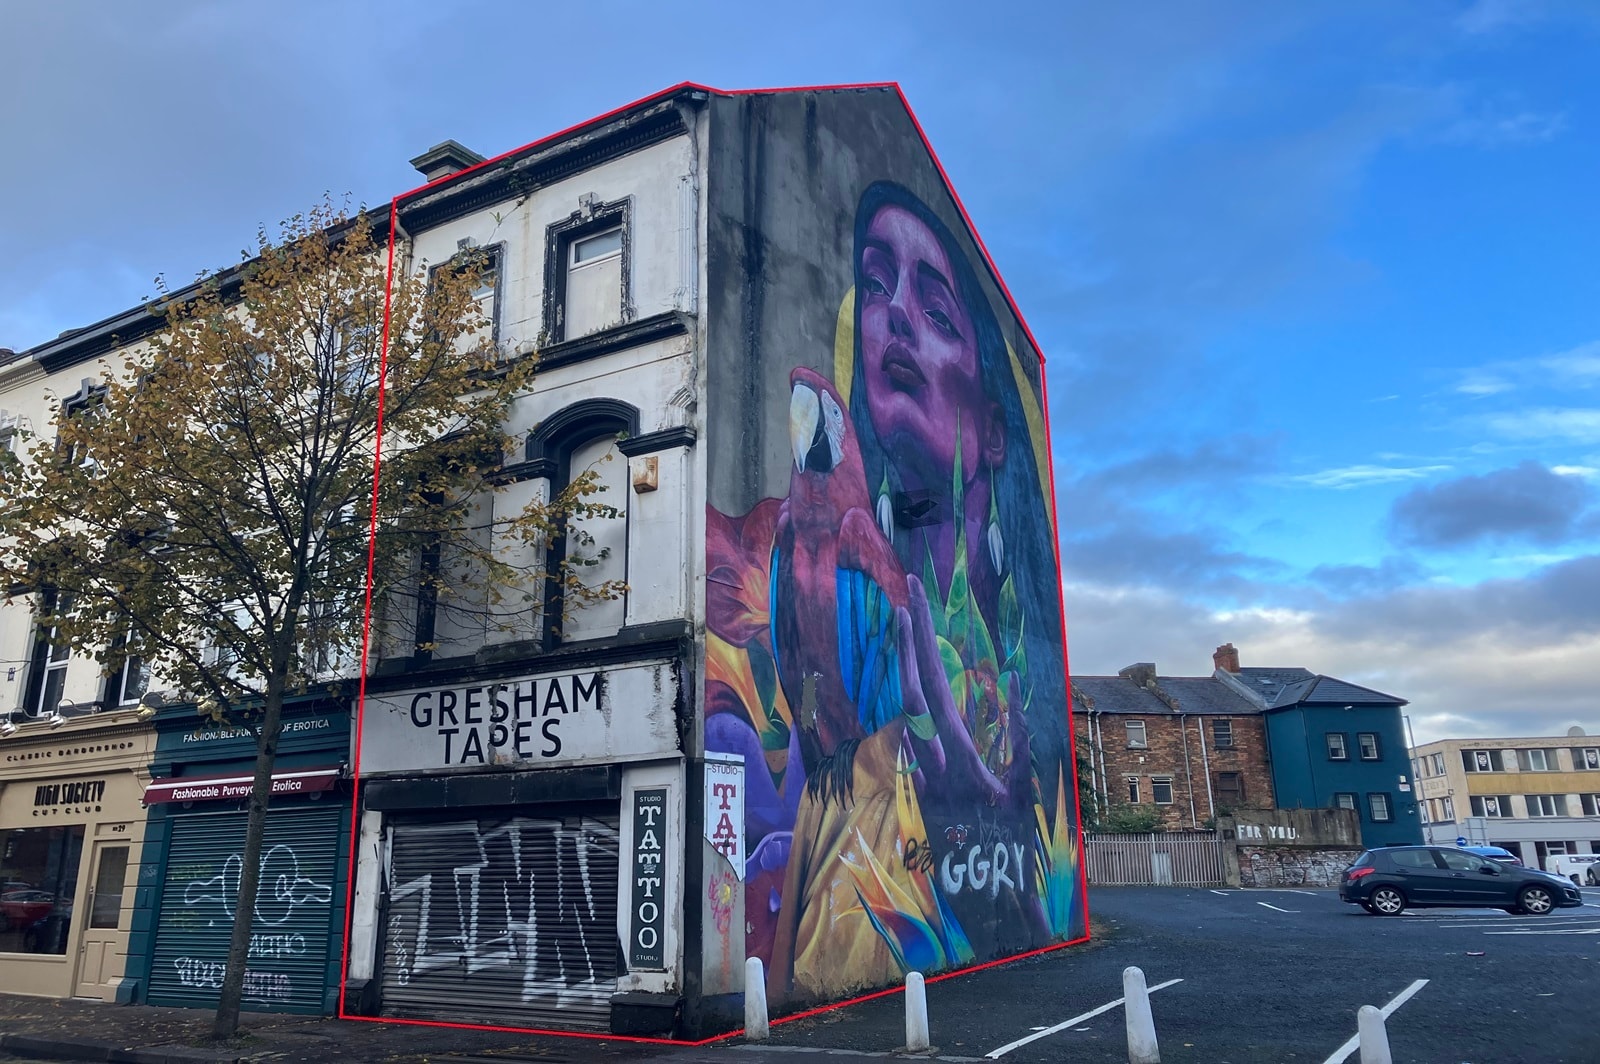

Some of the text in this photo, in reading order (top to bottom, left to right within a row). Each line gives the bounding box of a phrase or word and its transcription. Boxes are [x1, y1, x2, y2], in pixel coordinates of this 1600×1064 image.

[410, 673, 601, 728] GRESHAM
[293, 719, 329, 731] EROTICA
[438, 718, 562, 764] TAPES
[7, 742, 134, 762] CLASSIC BARBERSHOP
[711, 764, 738, 776] STUDIO
[34, 780, 106, 806] HIGH SOCIETY
[172, 785, 219, 799] Fashionable
[272, 780, 301, 792] Erotica
[639, 795, 662, 803] STUDIO
[32, 805, 102, 817] CUT CLUB
[1237, 824, 1262, 839] FOR
[637, 805, 661, 949] TATTOO
